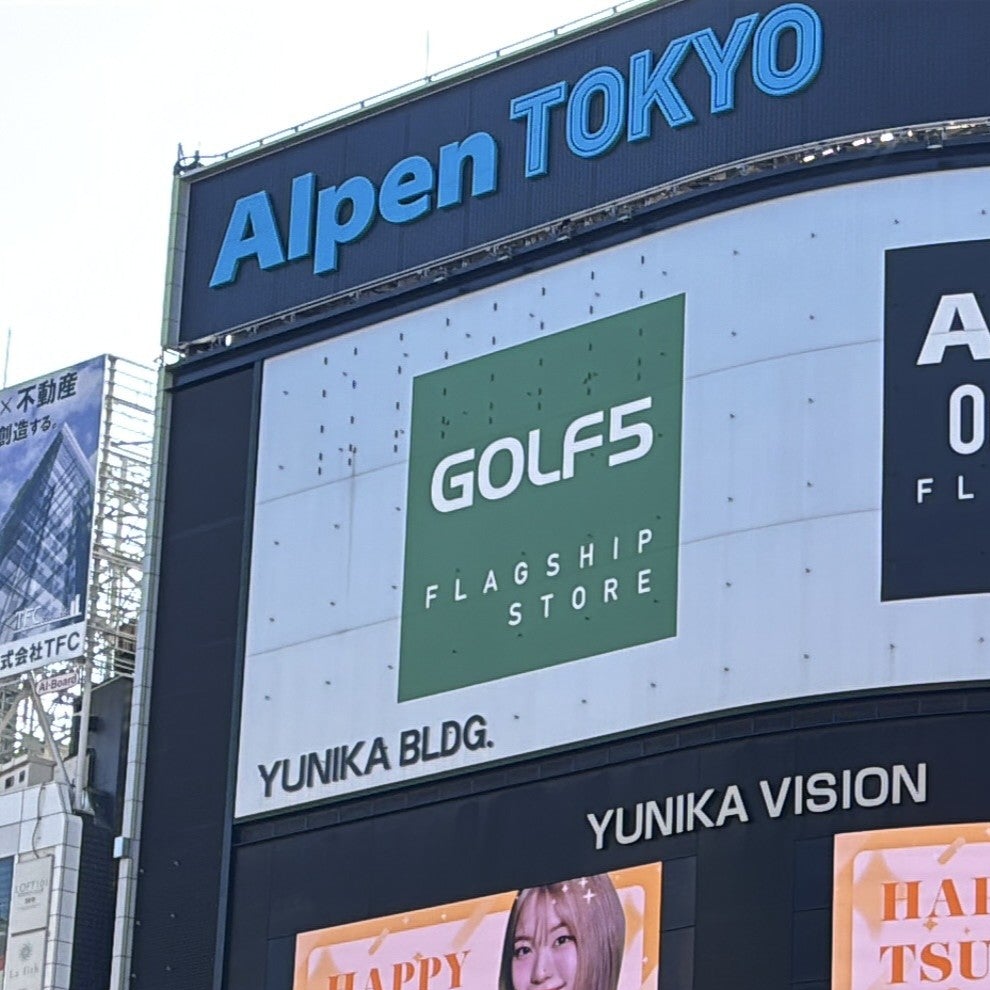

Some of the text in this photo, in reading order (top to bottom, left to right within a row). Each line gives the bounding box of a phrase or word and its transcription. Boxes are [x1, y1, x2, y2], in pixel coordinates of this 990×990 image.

[209, 2, 823, 289] Alpen TOKYO
[431, 396, 653, 513] GOLF5
[425, 528, 652, 608] FLAGSHIP
[508, 568, 651, 626] STORE
[258, 714, 494, 798] YUNIKA BLDG.
[587, 763, 927, 849] YUNIKA VISION
